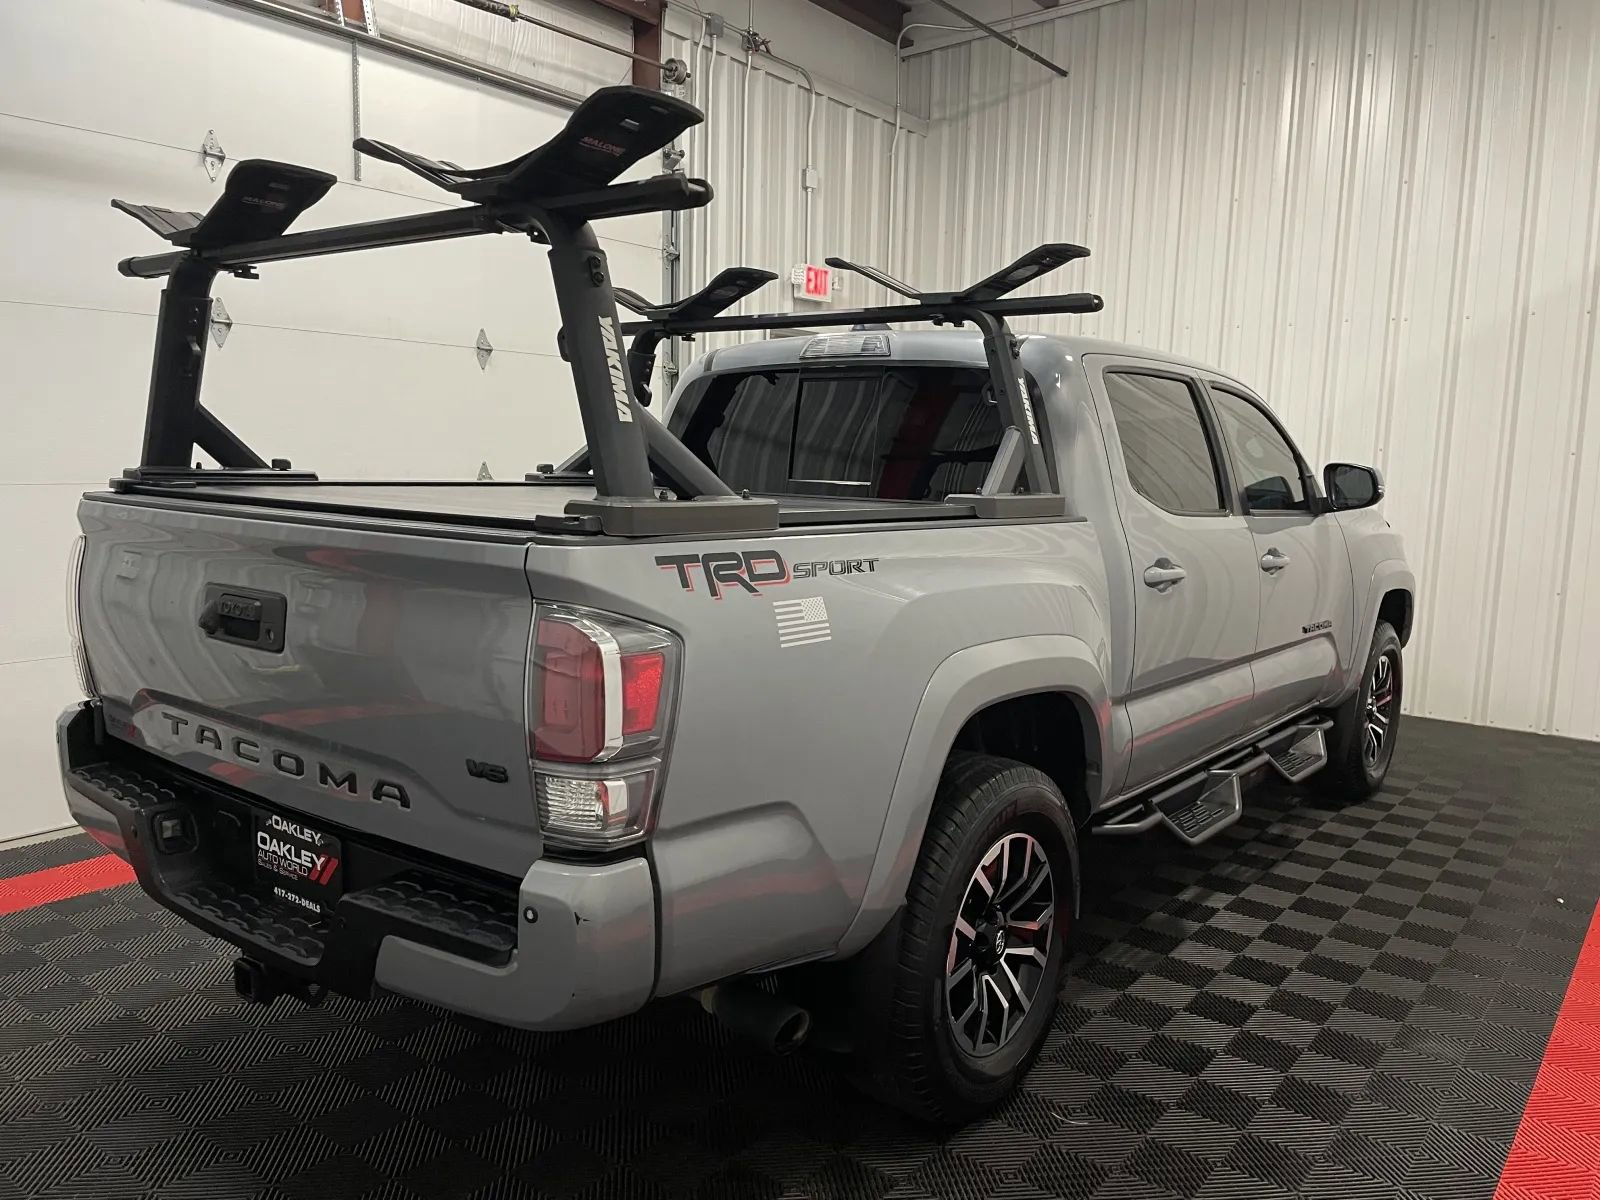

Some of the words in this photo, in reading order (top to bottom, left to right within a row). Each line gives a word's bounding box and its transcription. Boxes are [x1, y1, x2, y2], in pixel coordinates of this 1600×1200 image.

[806, 266, 829, 296] EXIT
[598, 316, 633, 422] YAKIMA
[654, 549, 791, 601] TRD
[792, 557, 879, 580] SPORT
[161, 711, 411, 811] TACOMA
[465, 758, 509, 784] V6
[271, 814, 322, 846] OAKLEY
[257, 831, 326, 871] OAKLEY
[257, 849, 279, 865] AUTO
[279, 856, 308, 876] WORLD
[273, 886, 321, 913] 417-272-DEALS
